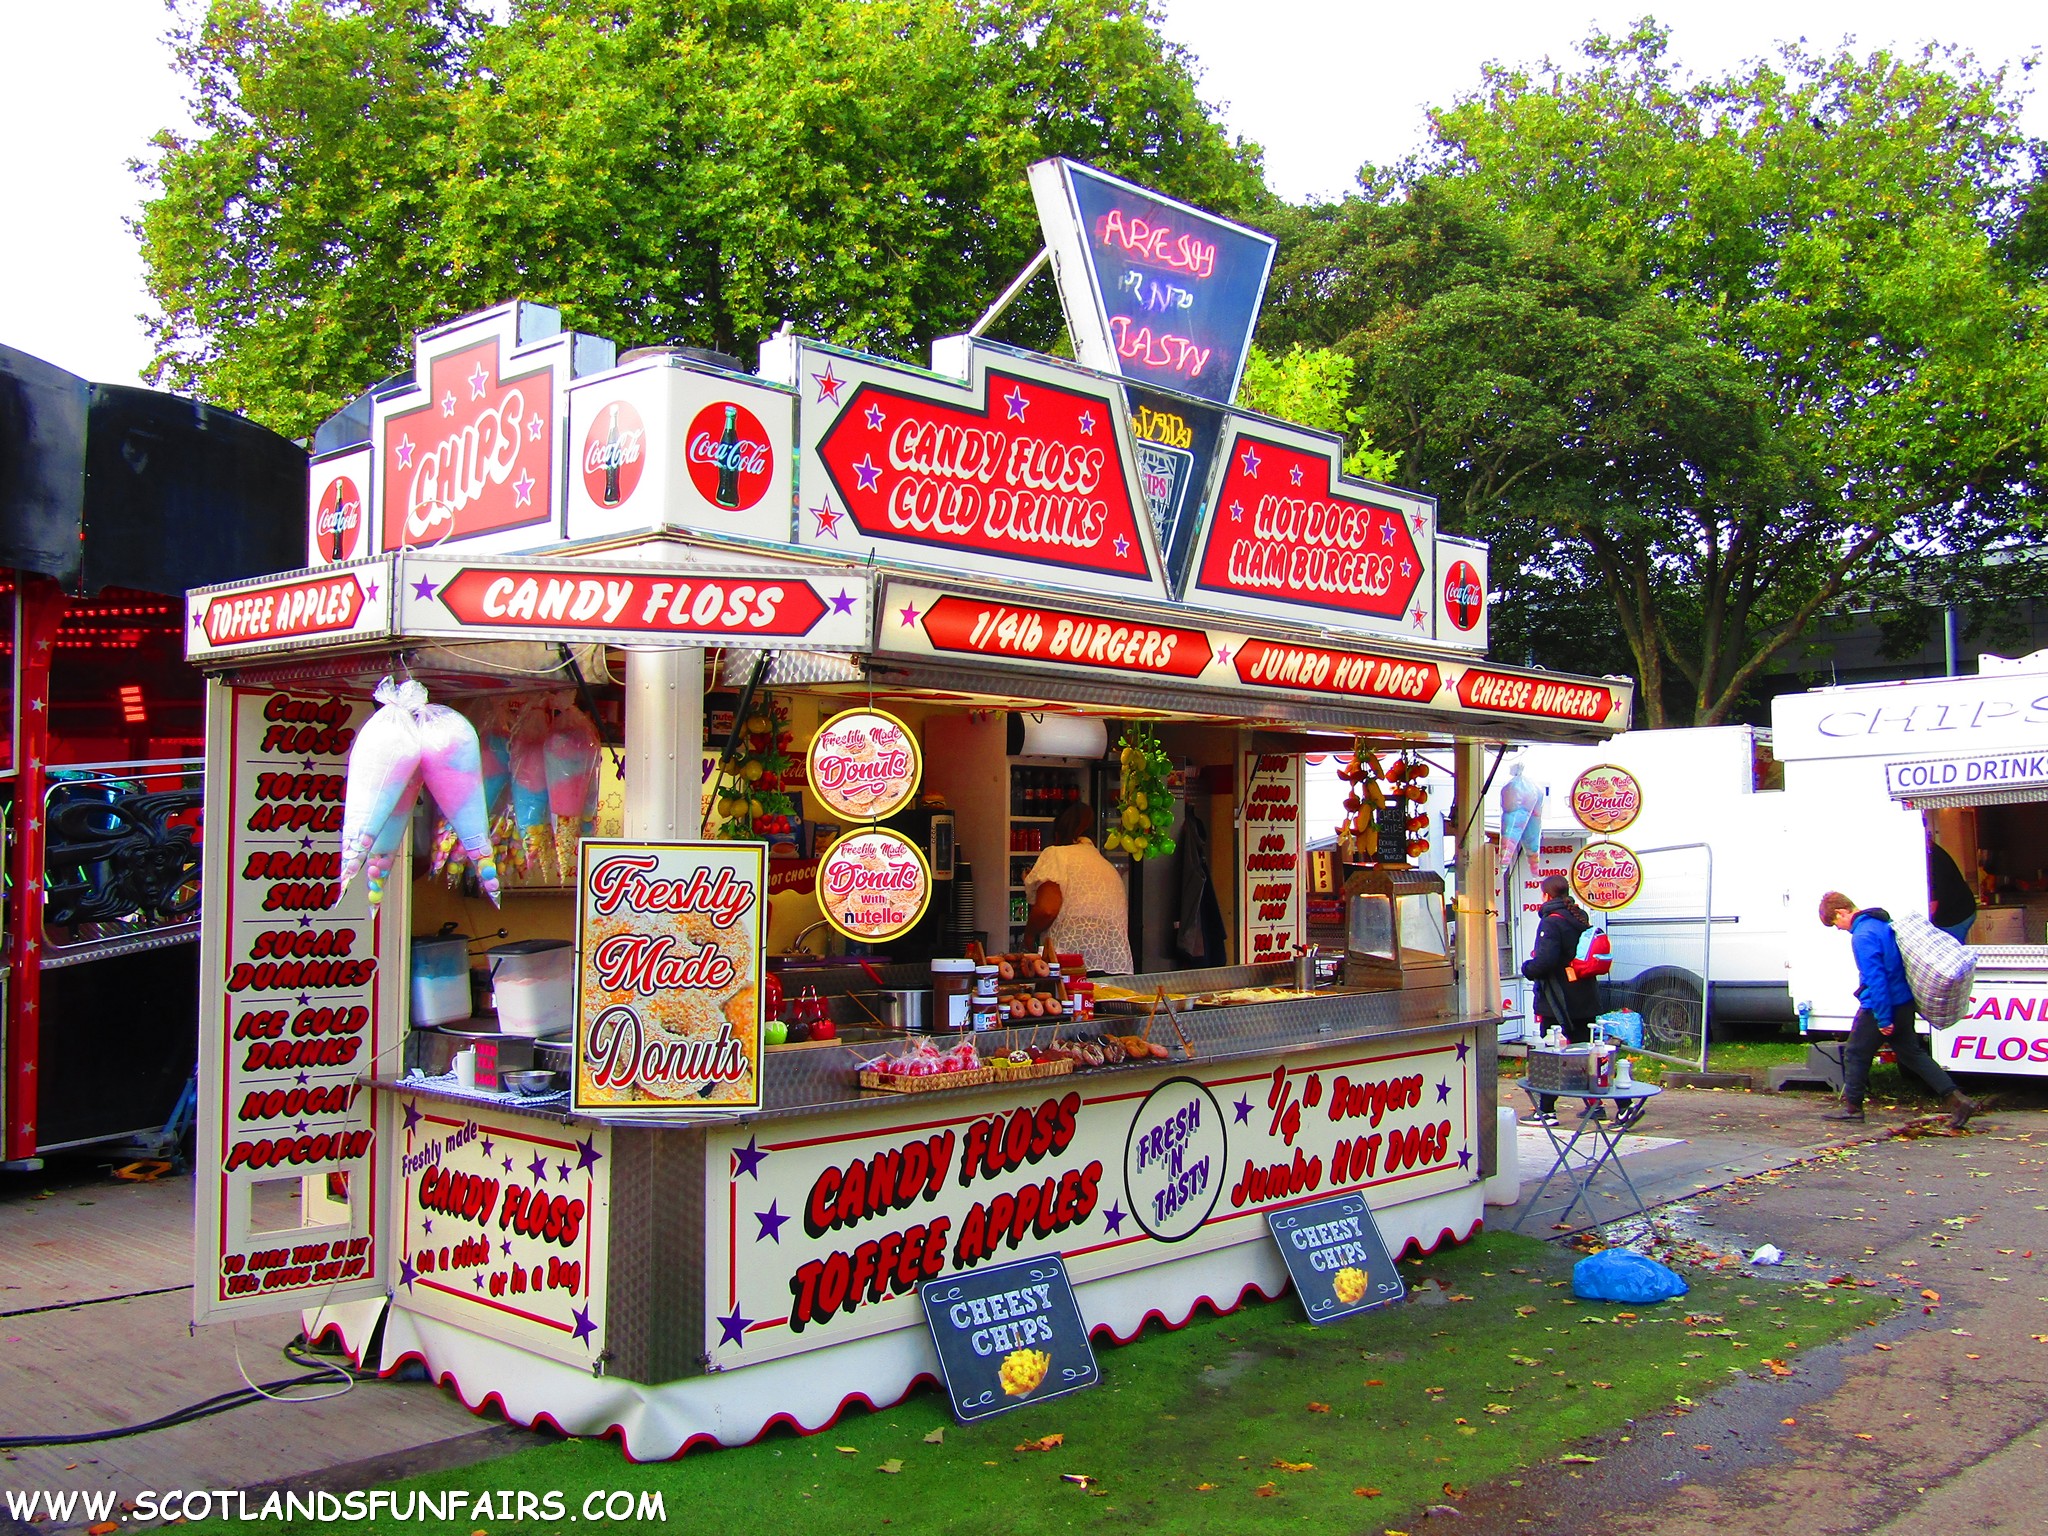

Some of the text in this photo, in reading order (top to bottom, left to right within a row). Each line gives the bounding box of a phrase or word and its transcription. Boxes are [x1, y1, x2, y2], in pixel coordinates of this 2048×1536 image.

[1110, 317, 1210, 376] TASTY
[408, 388, 524, 537] CHIPS
[889, 418, 1104, 494] CANDY FLOSS
[888, 477, 1107, 547] COLD DRINKS
[1254, 495, 1370, 548] HOT DOGS
[1228, 540, 1394, 596] HAM BURGERS
[211, 581, 355, 640] TOFFEE APPLES
[483, 577, 784, 628] CANDY FLOSS
[969, 610, 1178, 667] 1/4lb BURGERS
[1251, 647, 1429, 697] JUMBO HOT DOGS
[264, 694, 353, 730] Candy
[1471, 675, 1601, 718] CHEESE BURGERS
[261, 724, 356, 755] FLOSS
[820, 724, 902, 750] Freshly Made
[255, 772, 347, 802] TOFFE
[819, 750, 908, 789] Donuts
[1898, 755, 2048, 787] COLD DRINK
[247, 803, 345, 832] APPLE
[1268, 804, 1298, 821] DOGS
[1577, 791, 1634, 813] Donuts
[840, 842, 907, 859] Freshly Made
[1318, 851, 1327, 888] HIPS
[1540, 846, 1573, 854] RGERS
[785, 866, 816, 883] CHOCO
[828, 860, 919, 896] Donuts
[1539, 868, 1568, 877] UMBO
[1577, 861, 1634, 881] Donuts
[589, 855, 755, 929] Freshly
[861, 894, 885, 904] With
[1588, 890, 1626, 900] nutella
[844, 908, 903, 924] nutella
[250, 929, 356, 959] SUGAR
[227, 958, 377, 991] DUMMIES
[595, 934, 735, 995] Made
[233, 1006, 369, 1041] ICE COLD
[242, 1036, 362, 1072] DRINKS
[588, 1004, 748, 1089] Donuts
[1951, 1036, 2048, 1062] FLOS
[238, 1084, 362, 1121] NOUGAT
[1329, 1074, 1423, 1128] Burgers
[224, 1130, 372, 1172] POPCORN
[402, 1119, 478, 1177] Freshly made
[1136, 1098, 1200, 1174] FRESH
[803, 1091, 1081, 1240] CANDY FLOSS
[1231, 1120, 1451, 1208] Jumbo HOT DOGS
[419, 1164, 585, 1247] CANDY FLOSS
[1152, 1155, 1209, 1227] TASTY
[416, 1233, 490, 1274] on a stick
[788, 1160, 1103, 1333] TOFFEE APPLES
[1291, 1217, 1362, 1252] CHEESY
[224, 1254, 245, 1274] TO
[248, 1248, 290, 1271] HIRE
[292, 1243, 330, 1265] THIS
[1309, 1241, 1367, 1272] CHIPS
[489, 1256, 581, 1297] or in a Bag
[950, 1283, 1053, 1330] CHEESY
[971, 1315, 1053, 1357] CHIPS
